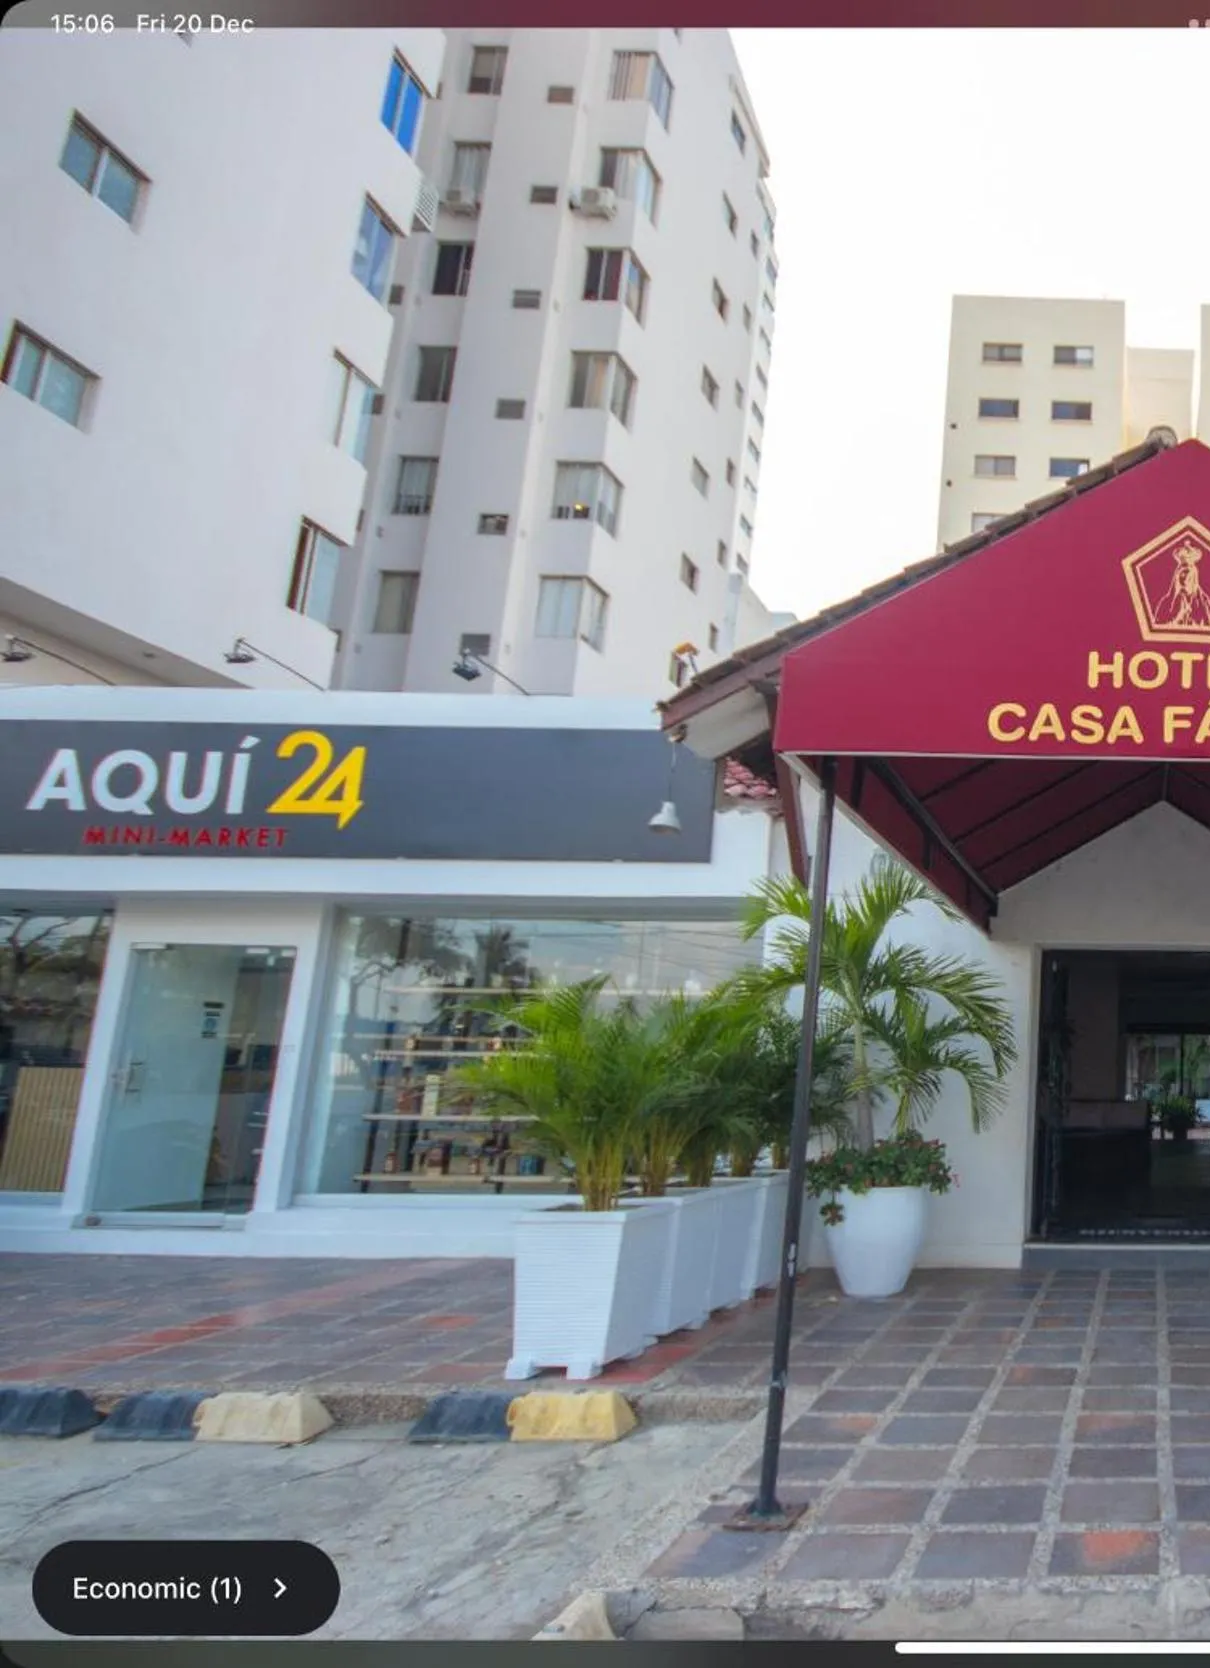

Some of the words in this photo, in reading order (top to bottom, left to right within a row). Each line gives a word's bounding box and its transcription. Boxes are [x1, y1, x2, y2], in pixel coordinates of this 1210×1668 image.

[987, 702, 1145, 745] CASA
[25, 735, 262, 817] AQUÍ
[265, 729, 368, 830] 24
[82, 825, 289, 848] MINI-MARKET
